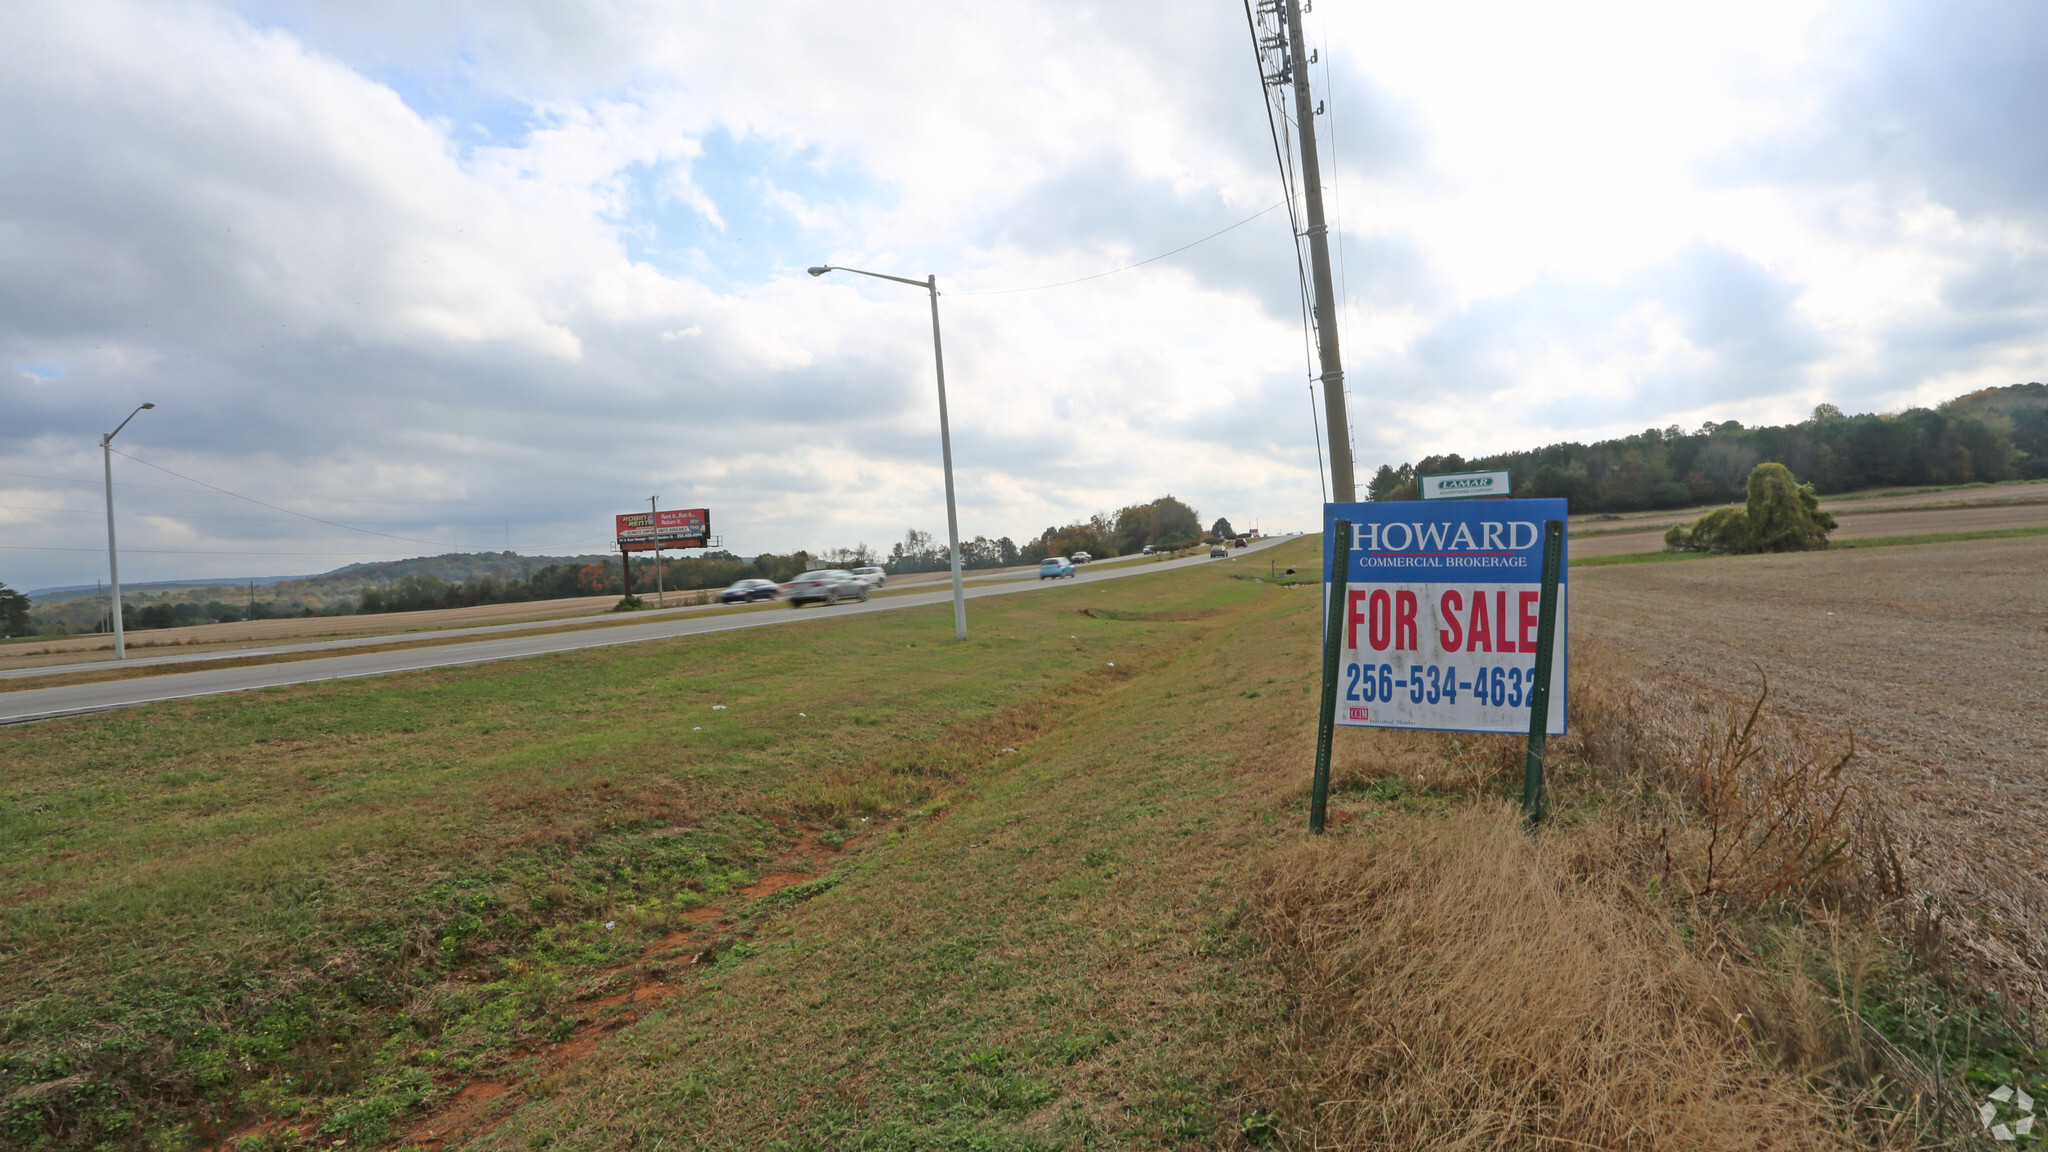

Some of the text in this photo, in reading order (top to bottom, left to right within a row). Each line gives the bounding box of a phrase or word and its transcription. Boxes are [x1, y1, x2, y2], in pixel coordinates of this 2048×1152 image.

[1442, 479, 1488, 488] LAMAR
[1350, 521, 1539, 551] HOWARD
[1359, 556, 1527, 568] COMMERCIAL BROKERAGE
[1347, 589, 1418, 651] FOR
[1440, 590, 1539, 653] SALE
[1346, 662, 1535, 708] 256-534-4632
[1350, 708, 1368, 718] CCIM
